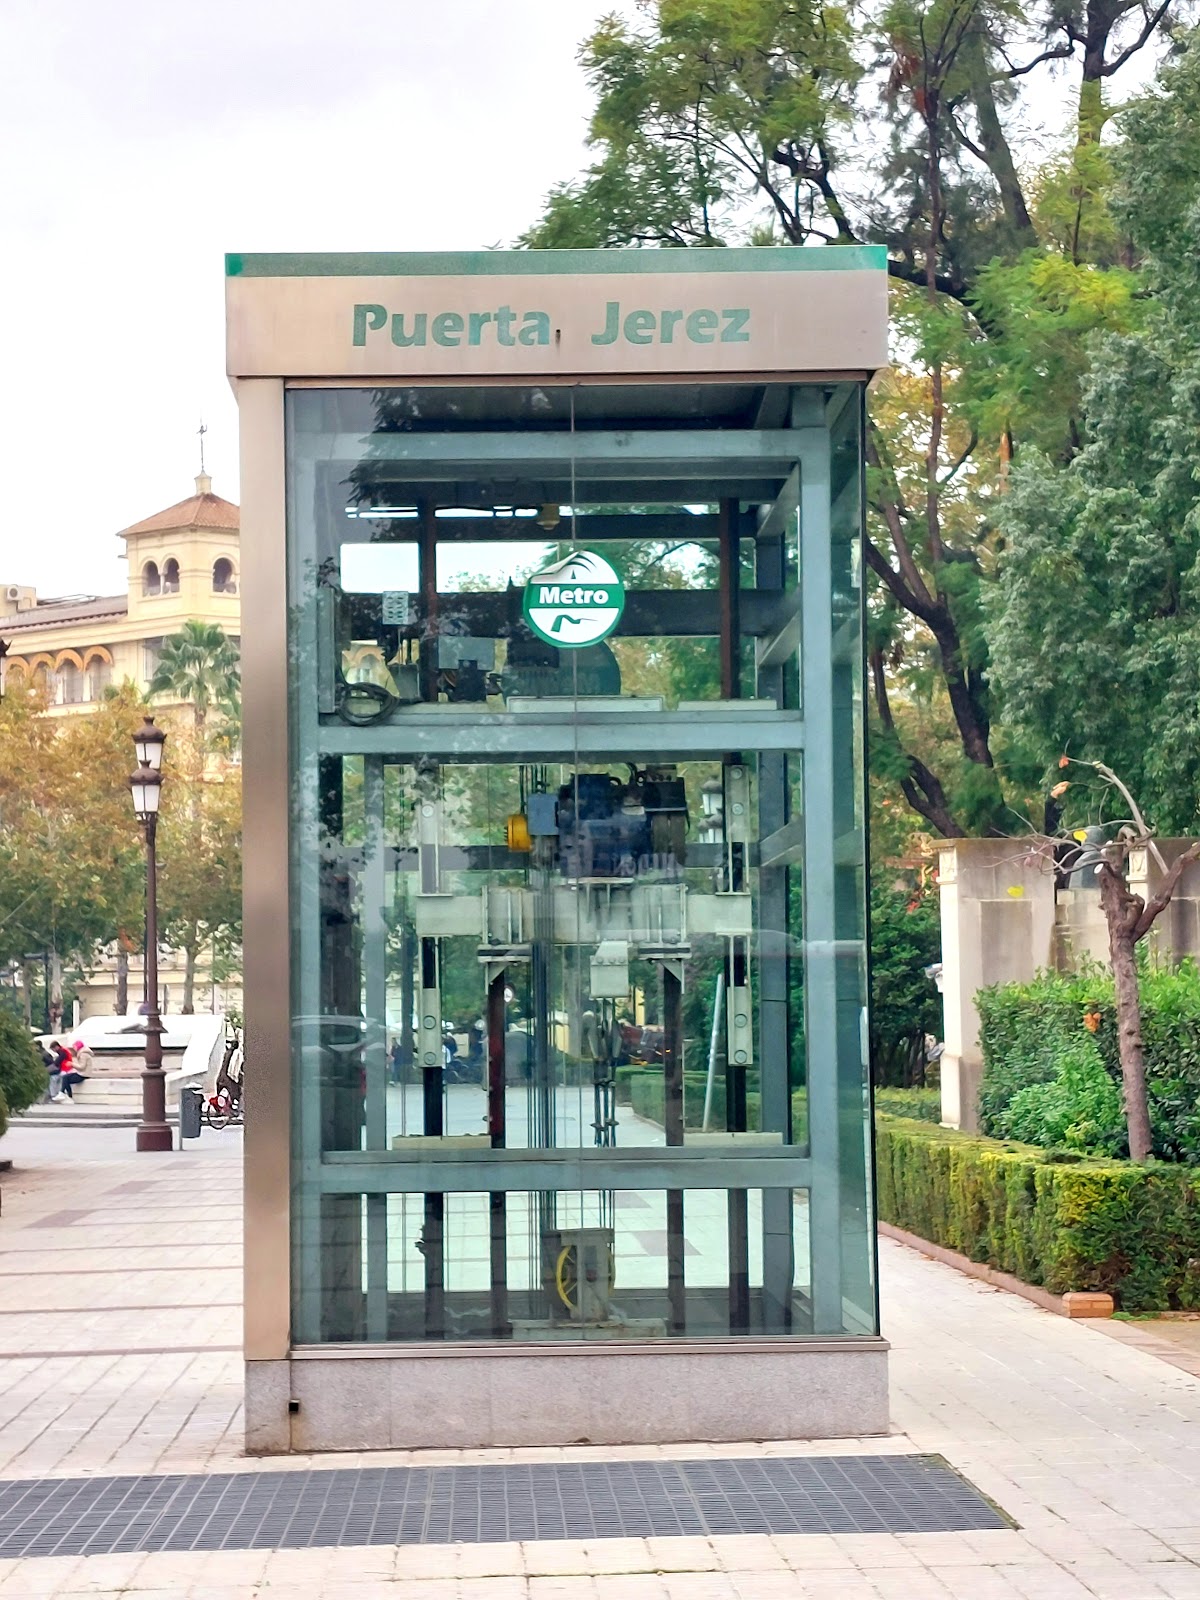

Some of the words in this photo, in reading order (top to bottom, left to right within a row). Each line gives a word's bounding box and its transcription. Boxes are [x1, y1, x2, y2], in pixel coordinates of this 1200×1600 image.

[352, 304, 551, 347] Puerta
[590, 301, 751, 345] Jerez
[539, 586, 609, 604] Metro
